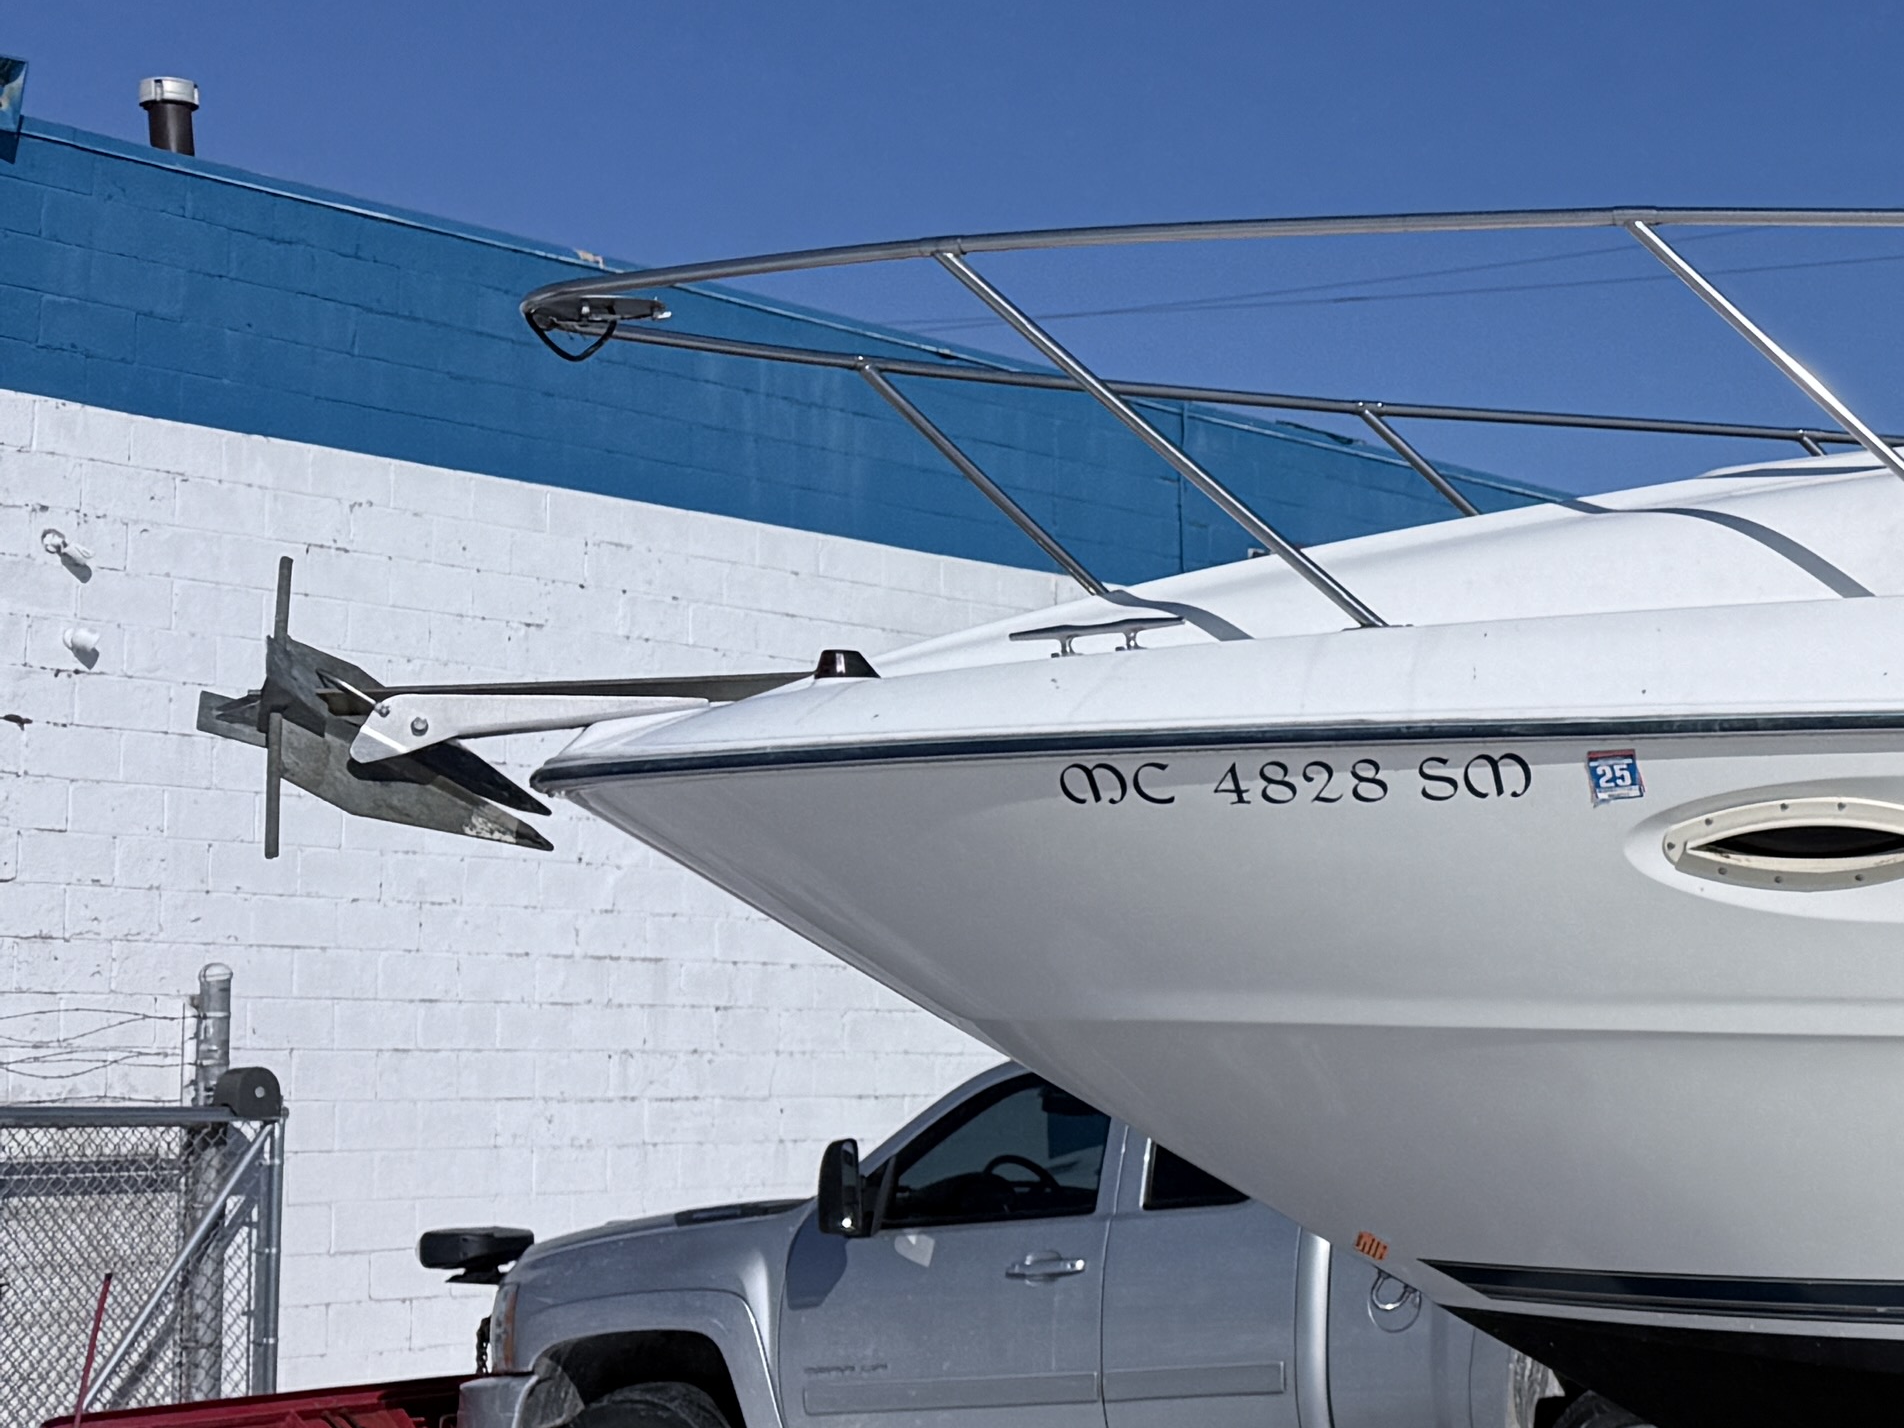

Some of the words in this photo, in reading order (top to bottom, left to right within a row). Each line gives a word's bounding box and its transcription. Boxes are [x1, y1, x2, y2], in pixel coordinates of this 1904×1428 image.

[1059, 762, 1176, 804] MC
[1213, 758, 1389, 804] 4828
[1418, 752, 1532, 801] SM
[1596, 764, 1632, 788] 25
